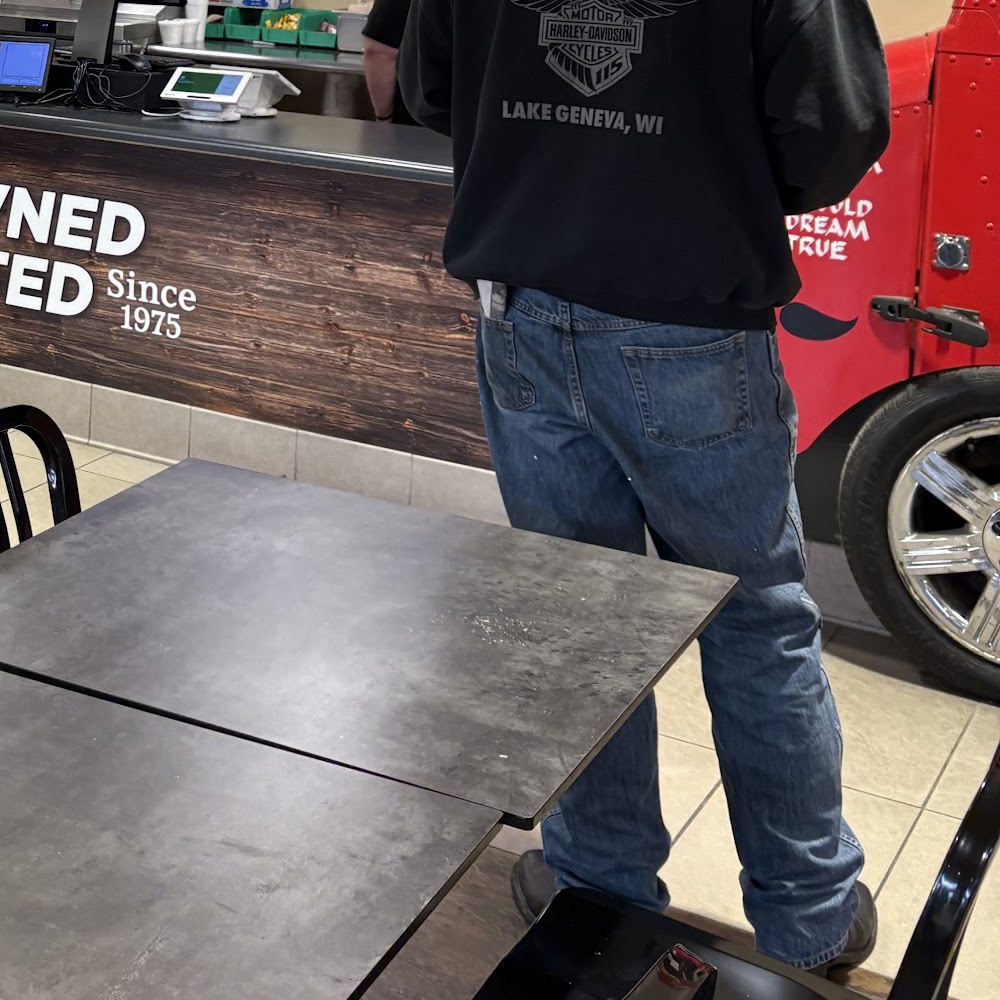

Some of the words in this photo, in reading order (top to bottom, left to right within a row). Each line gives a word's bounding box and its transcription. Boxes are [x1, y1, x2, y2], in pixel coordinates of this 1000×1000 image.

[572, 5, 614, 22] MOTOR
[550, 23, 632, 42] HARLEY-DAVIDSON
[569, 43, 612, 62] CYCLES
[502, 100, 552, 121] LAKE
[555, 104, 631, 135] GENEVA,
[635, 112, 664, 135] WI
[784, 214, 870, 241] DREAM
[788, 234, 848, 260] TRUE
[106, 269, 197, 313] Since
[120, 304, 182, 339] 1975
